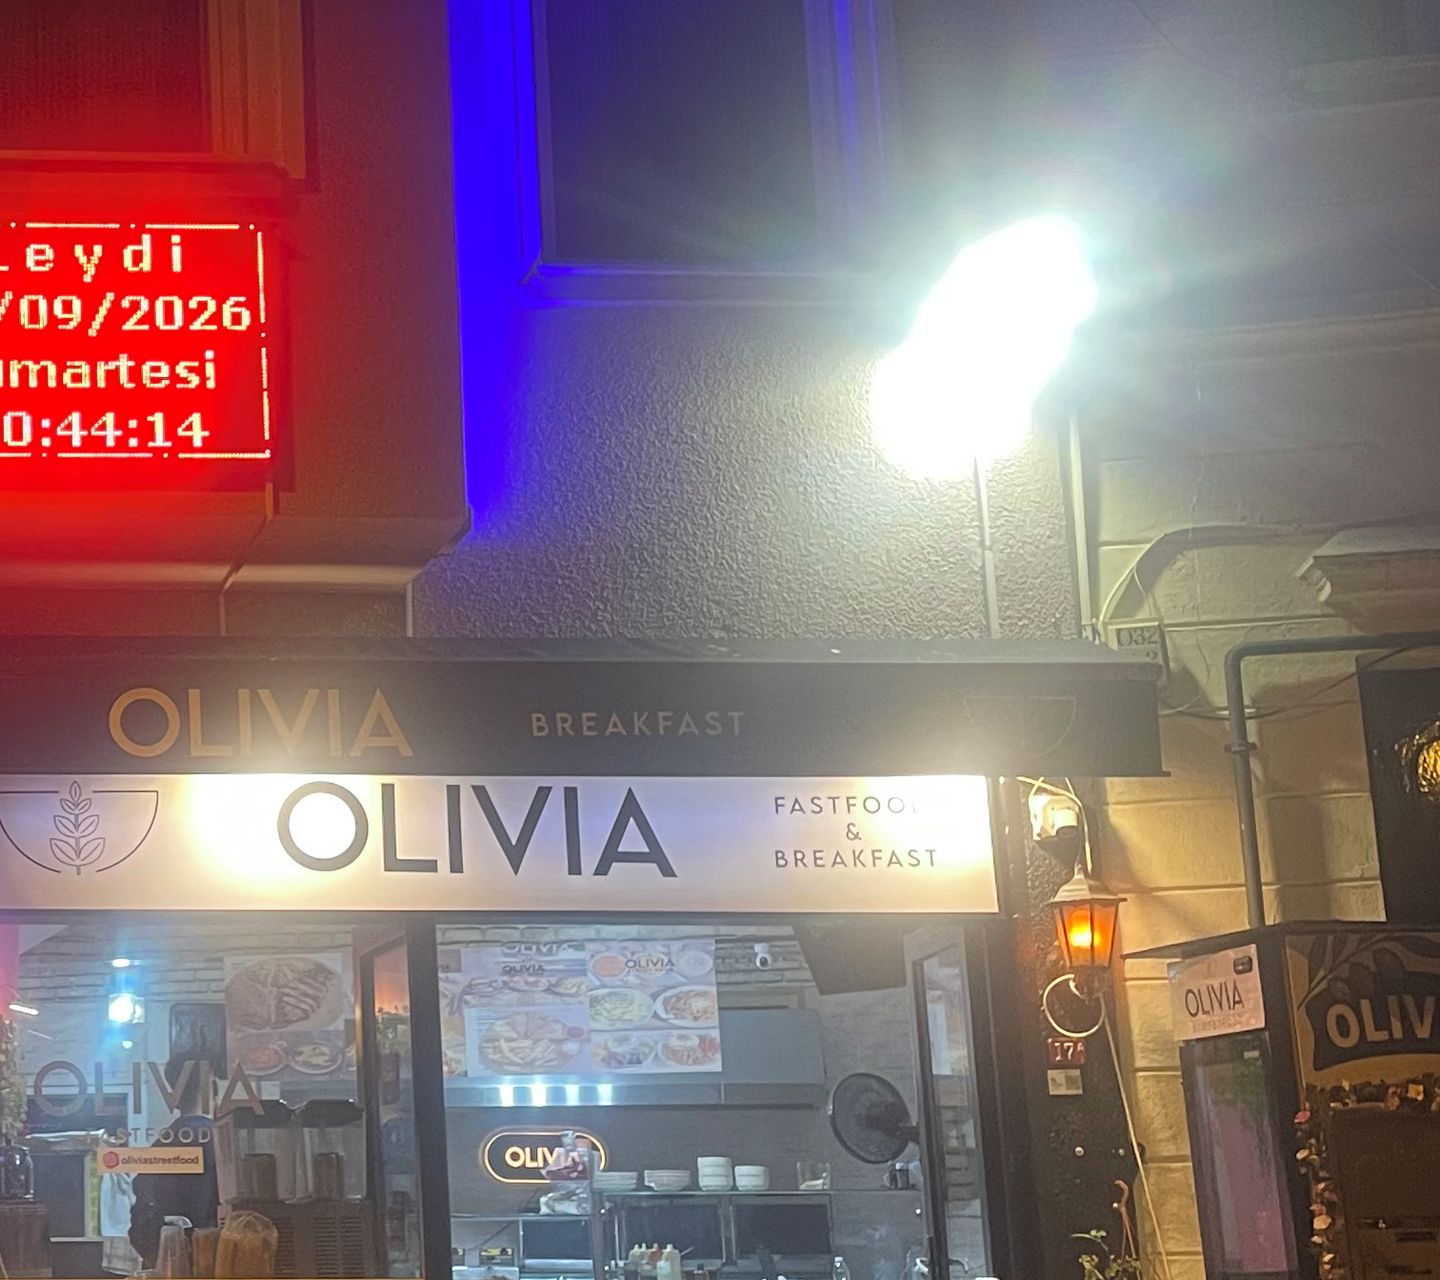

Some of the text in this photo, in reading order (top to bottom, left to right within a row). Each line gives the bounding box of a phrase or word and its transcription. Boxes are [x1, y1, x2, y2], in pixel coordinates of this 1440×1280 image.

[108, 686, 414, 759] OLIVIA
[531, 711, 745, 737] BREAKFAST
[276, 780, 679, 878] OLIVIA
[845, 822, 863, 842] &
[774, 848, 938, 869] BREAKFAST
[1184, 977, 1246, 1018] OLIVIA
[1325, 993, 1437, 1049] OLIV
[33, 1059, 266, 1117] OLIVIA
